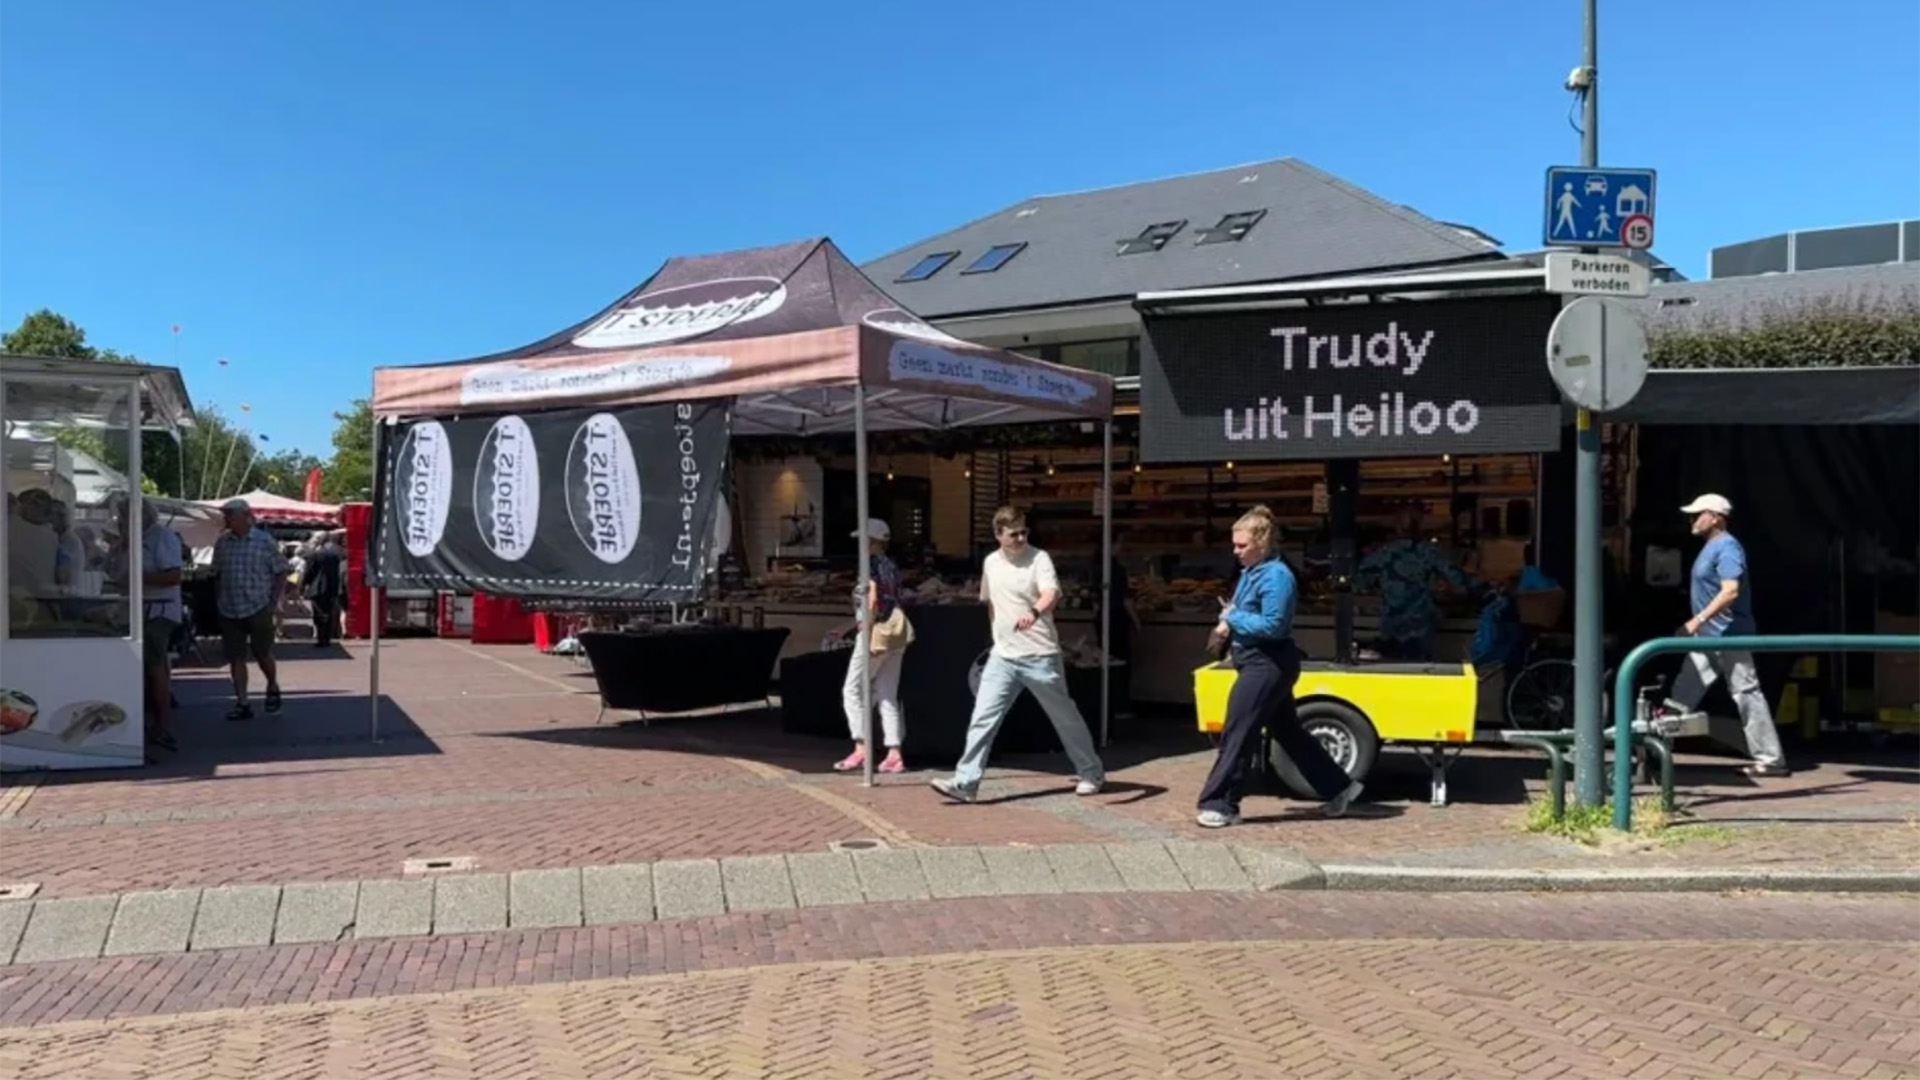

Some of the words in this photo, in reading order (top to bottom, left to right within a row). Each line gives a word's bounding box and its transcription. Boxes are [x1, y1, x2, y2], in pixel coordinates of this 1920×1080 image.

[1630, 226, 1647, 242] 15
[1571, 258, 1630, 274] Parkeren
[1571, 277, 1630, 292] verboden
[1270, 321, 1435, 376] Trudy
[1224, 397, 1289, 440] uit
[1303, 391, 1480, 438] Heiloo
